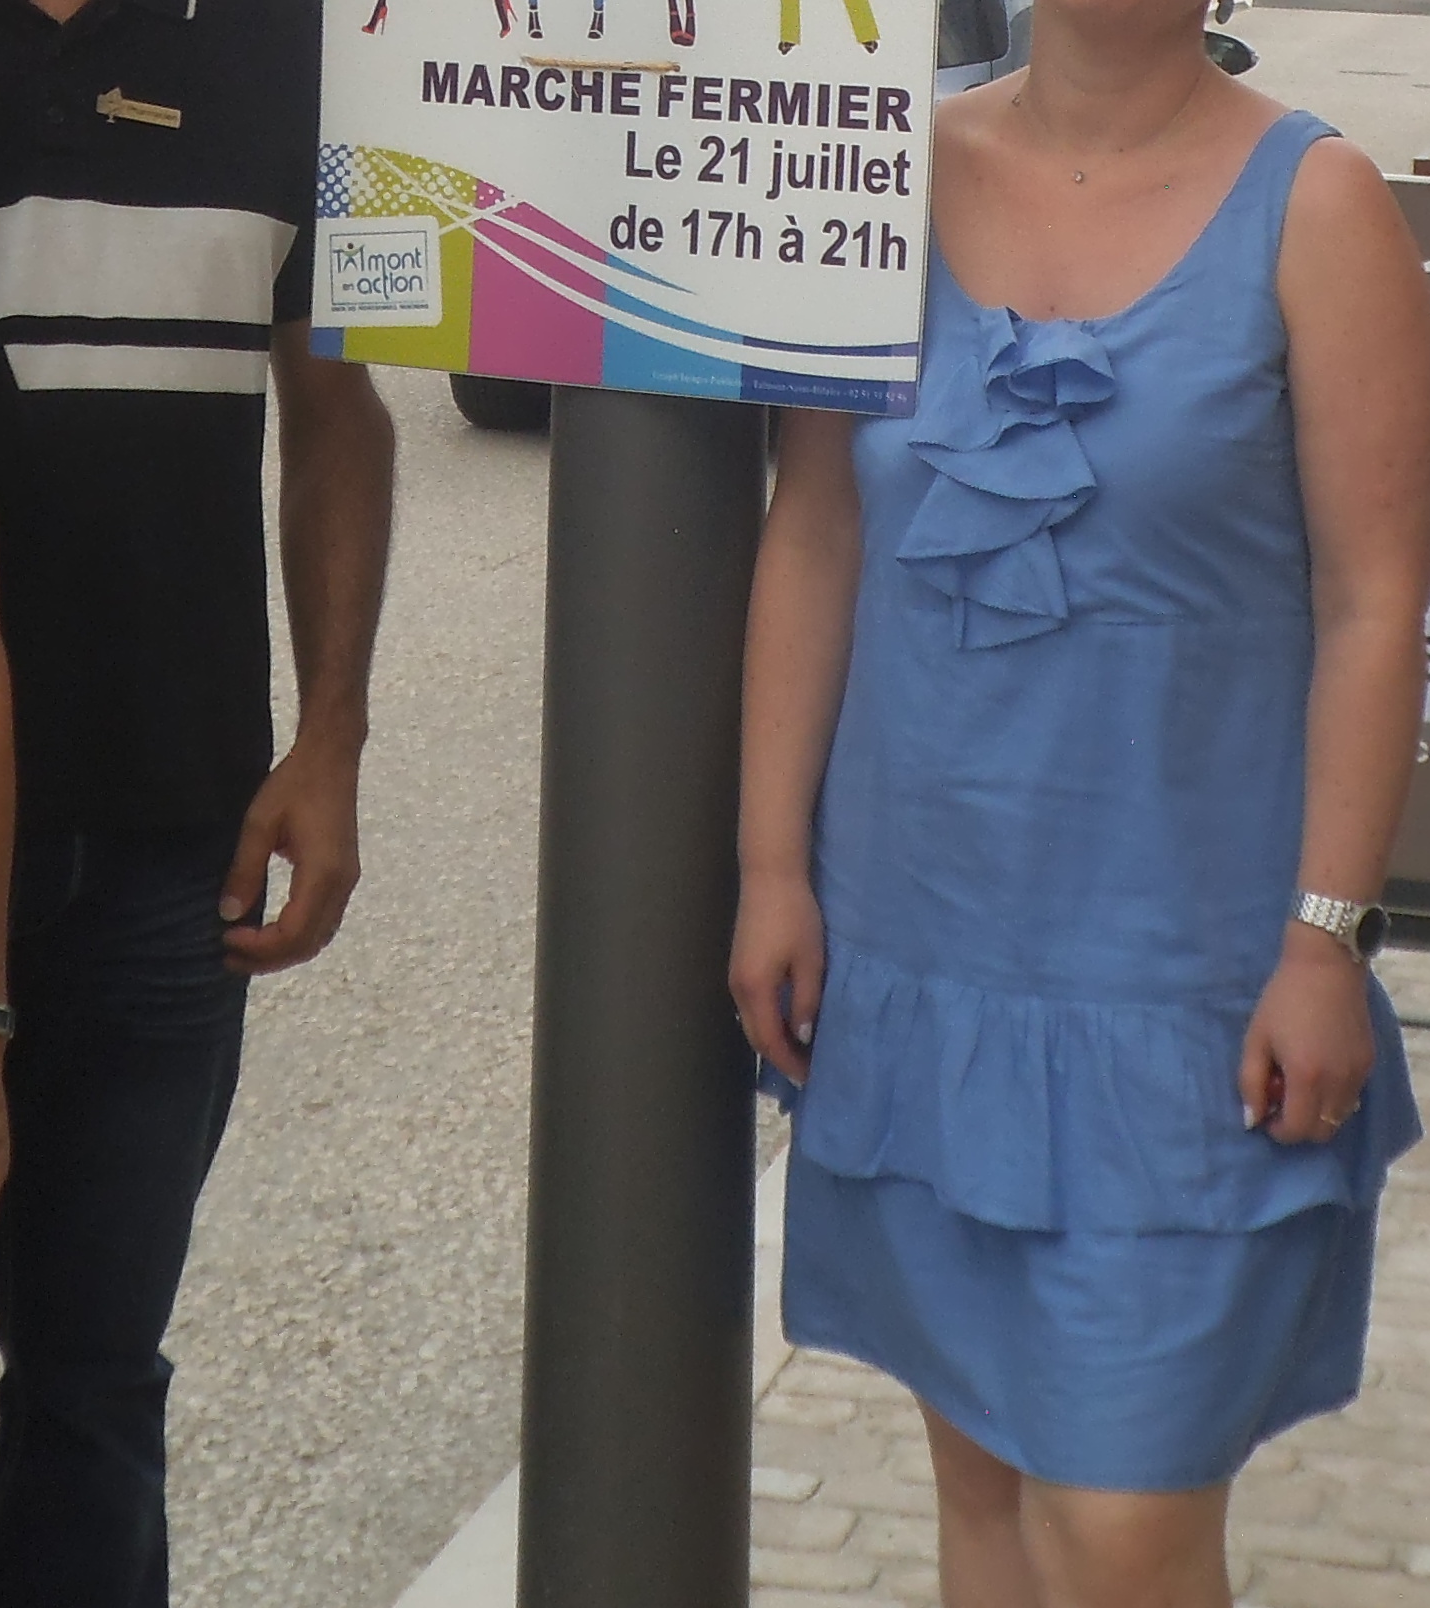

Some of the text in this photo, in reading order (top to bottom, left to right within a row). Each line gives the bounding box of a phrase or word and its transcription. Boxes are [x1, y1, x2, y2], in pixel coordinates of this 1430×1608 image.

[421, 61, 913, 133] MARCHE FERMIER
[625, 130, 911, 199] Le 21 juillet
[609, 204, 909, 271] de 17h à 21h
